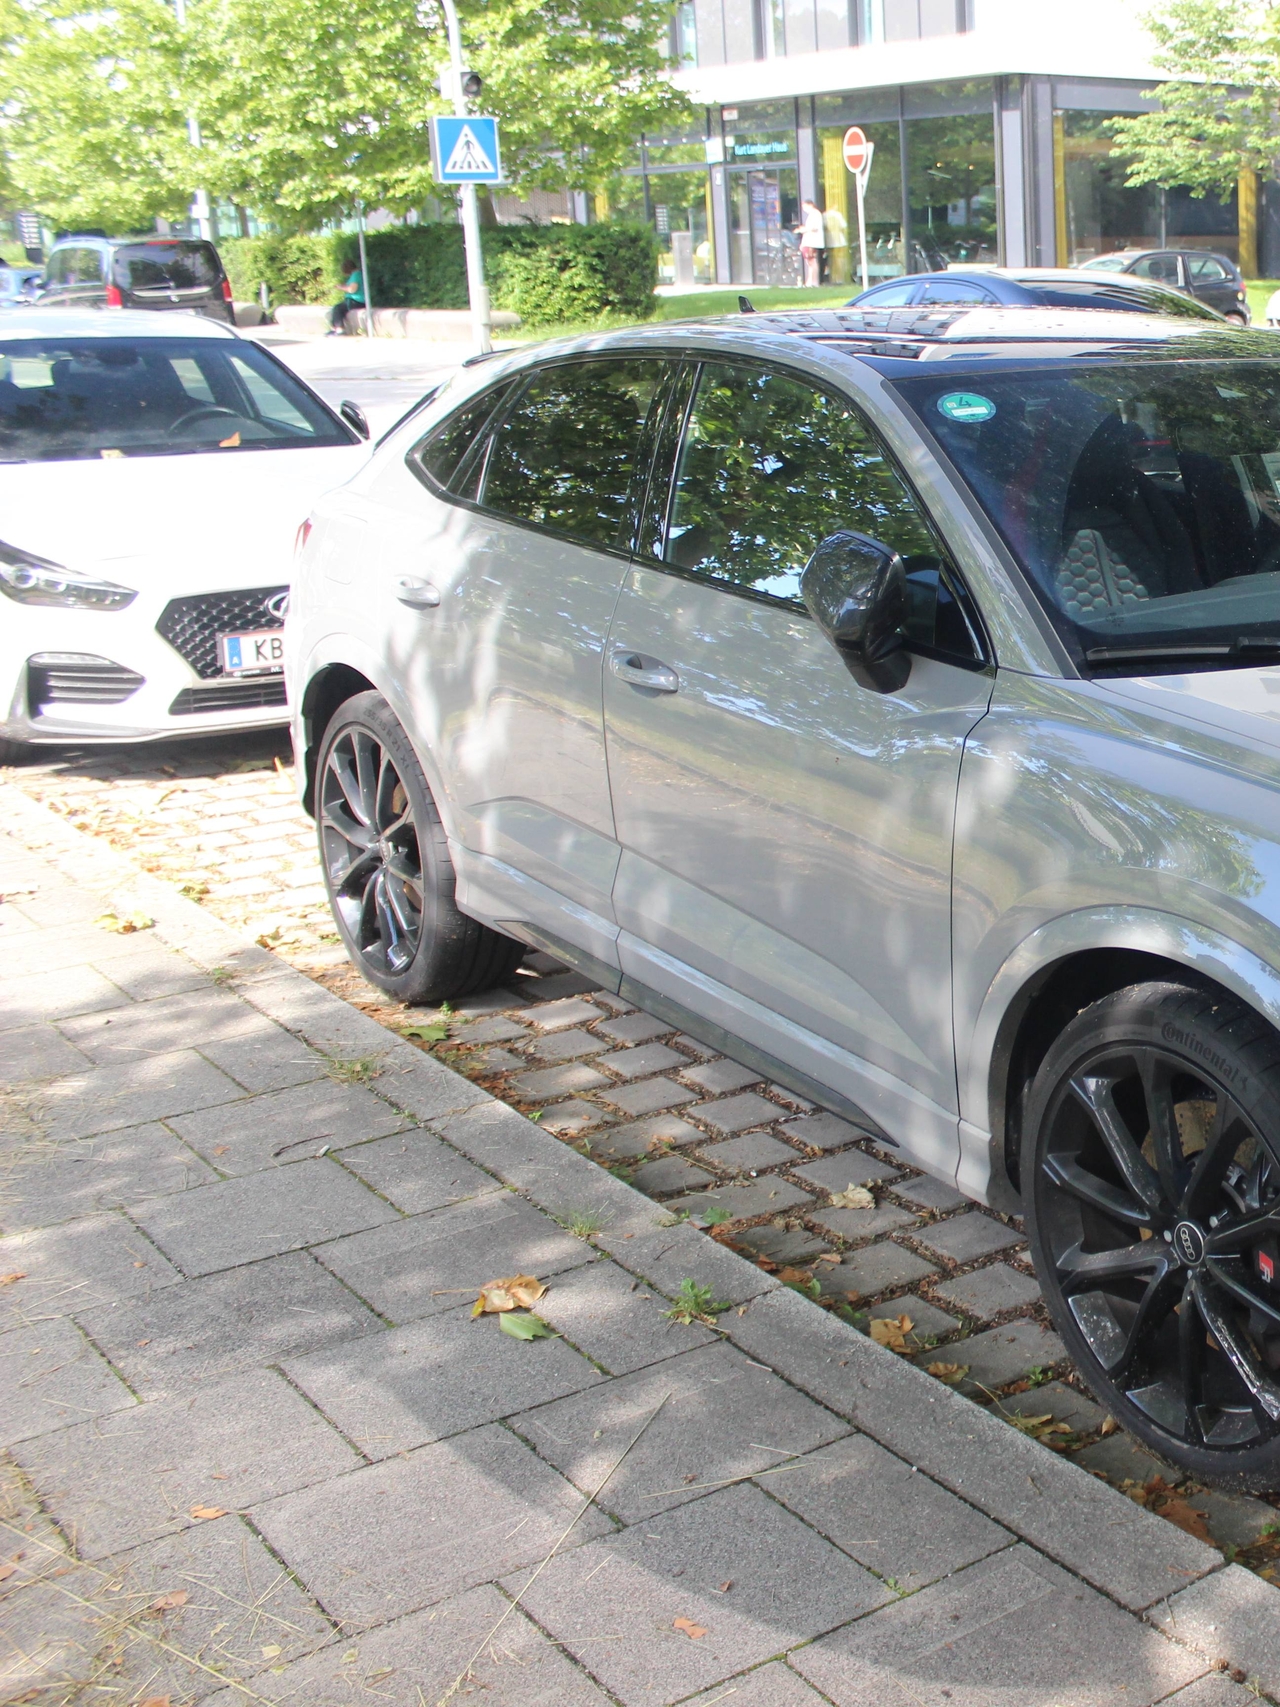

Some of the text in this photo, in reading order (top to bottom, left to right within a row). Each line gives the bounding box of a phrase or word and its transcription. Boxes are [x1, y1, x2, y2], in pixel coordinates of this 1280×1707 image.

[959, 396, 972, 407] 4
[254, 637, 283, 662] KB
[232, 656, 239, 664] A
[1160, 1021, 1240, 1084] Continental
